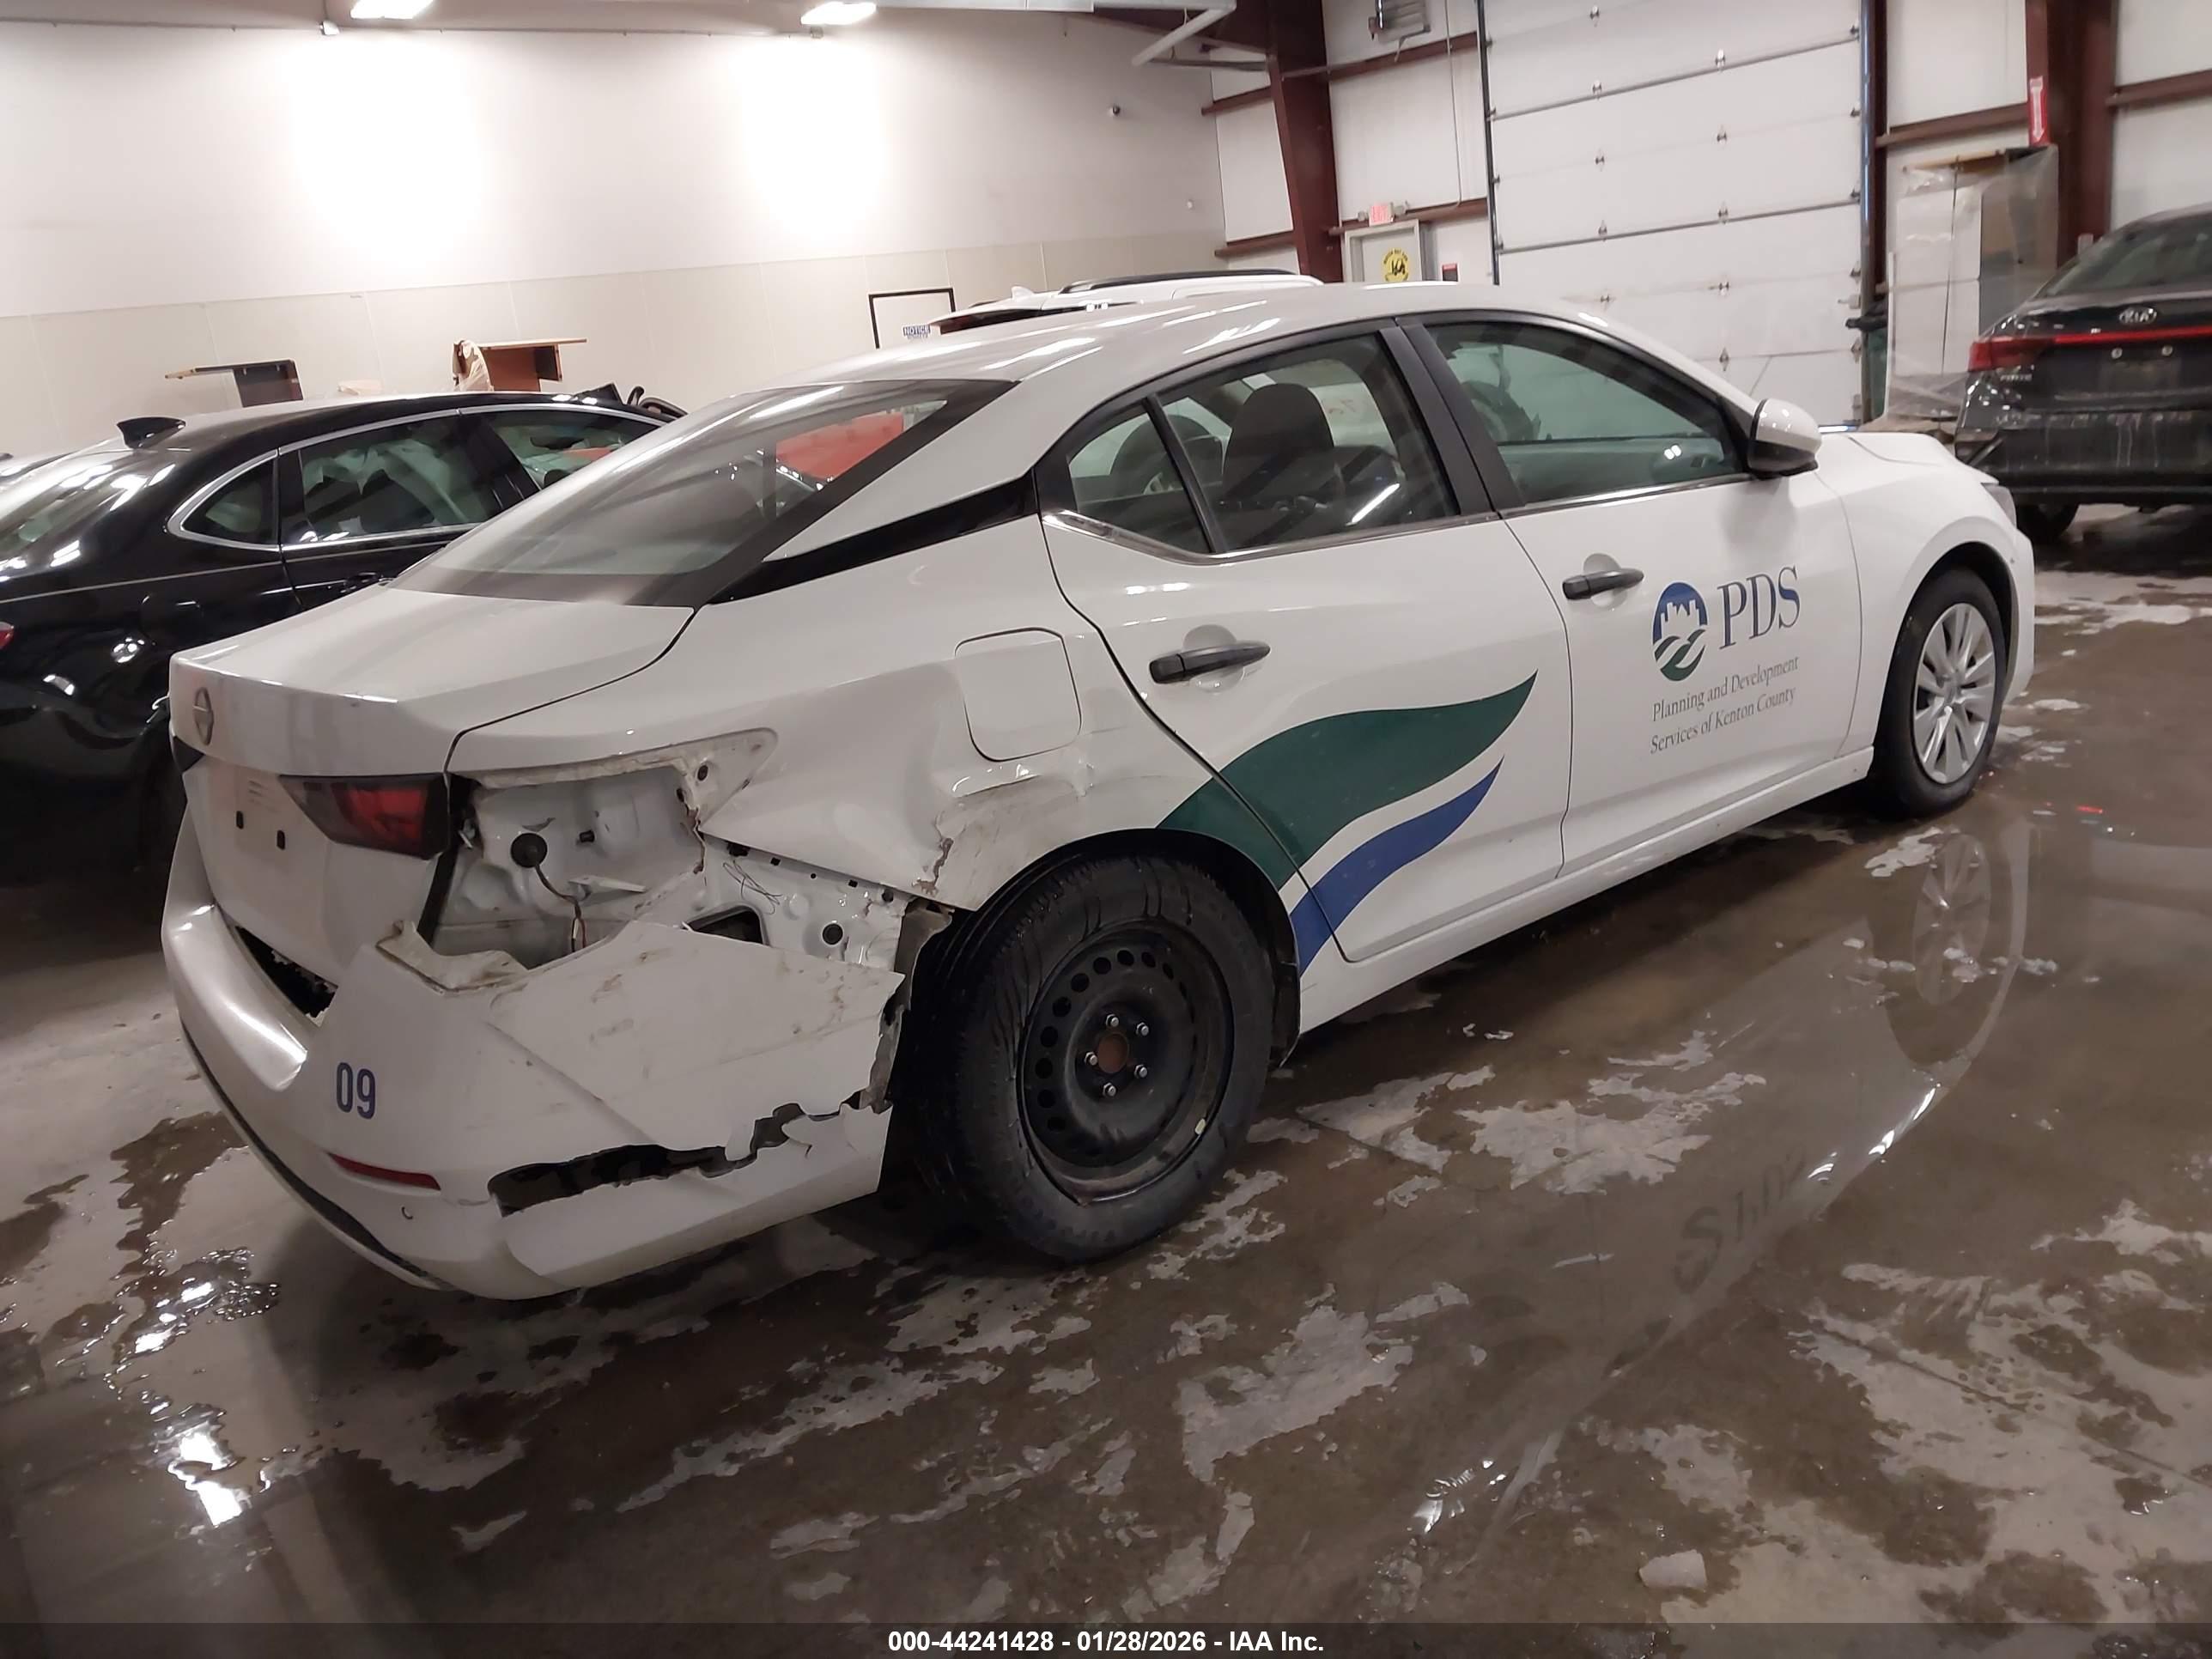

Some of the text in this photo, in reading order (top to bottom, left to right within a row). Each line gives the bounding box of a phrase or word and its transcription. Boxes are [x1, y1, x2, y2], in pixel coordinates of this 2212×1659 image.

[2121, 307, 2155, 325] KIA
[1717, 565, 1801, 650] PDS
[1650, 688, 1796, 754] Services of Kenton County
[1653, 656, 1799, 721] Planning and Development
[336, 1061, 376, 1120] 09
